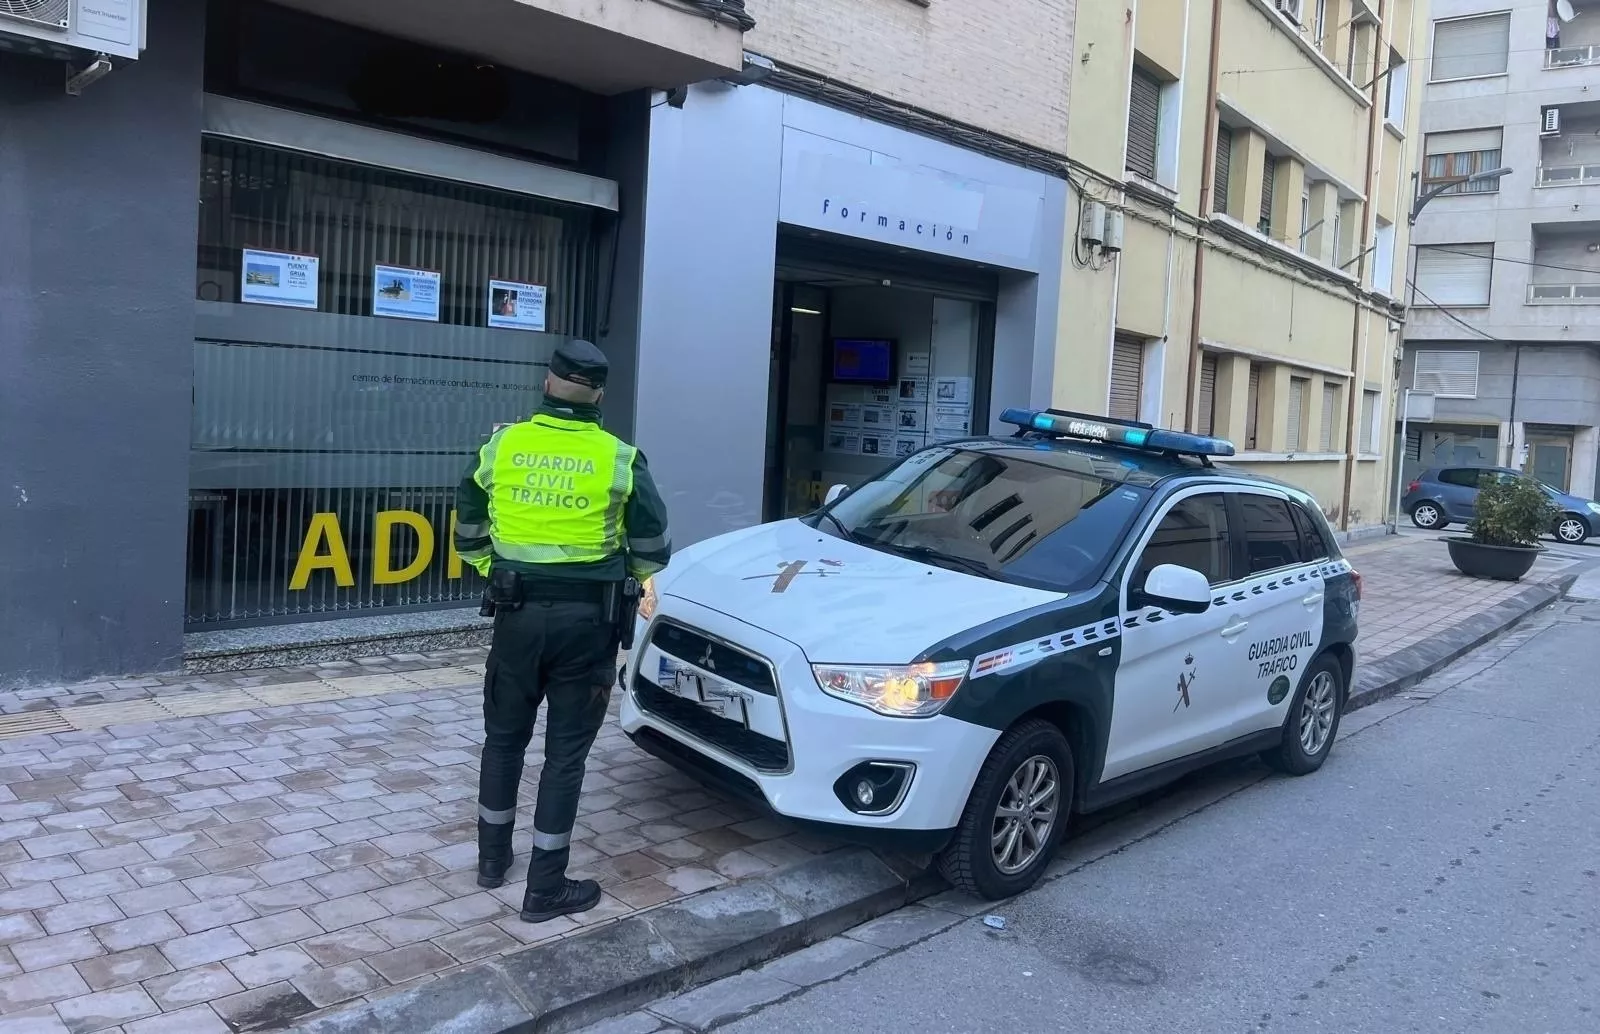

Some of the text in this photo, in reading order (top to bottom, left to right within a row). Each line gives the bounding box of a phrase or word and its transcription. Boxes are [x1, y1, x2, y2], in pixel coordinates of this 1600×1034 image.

[823, 199, 969, 245] formación
[352, 373, 380, 383] centro
[381, 374, 392, 384] de
[436, 378, 447, 387] de
[447, 379, 493, 390] conductores
[512, 453, 594, 475] GUARDIA
[526, 472, 574, 491] CIVIL
[511, 487, 590, 509] TRAFICO
[1248, 630, 1313, 661] GUARDIA CIVIL
[1257, 654, 1298, 679] TRÁFICO
